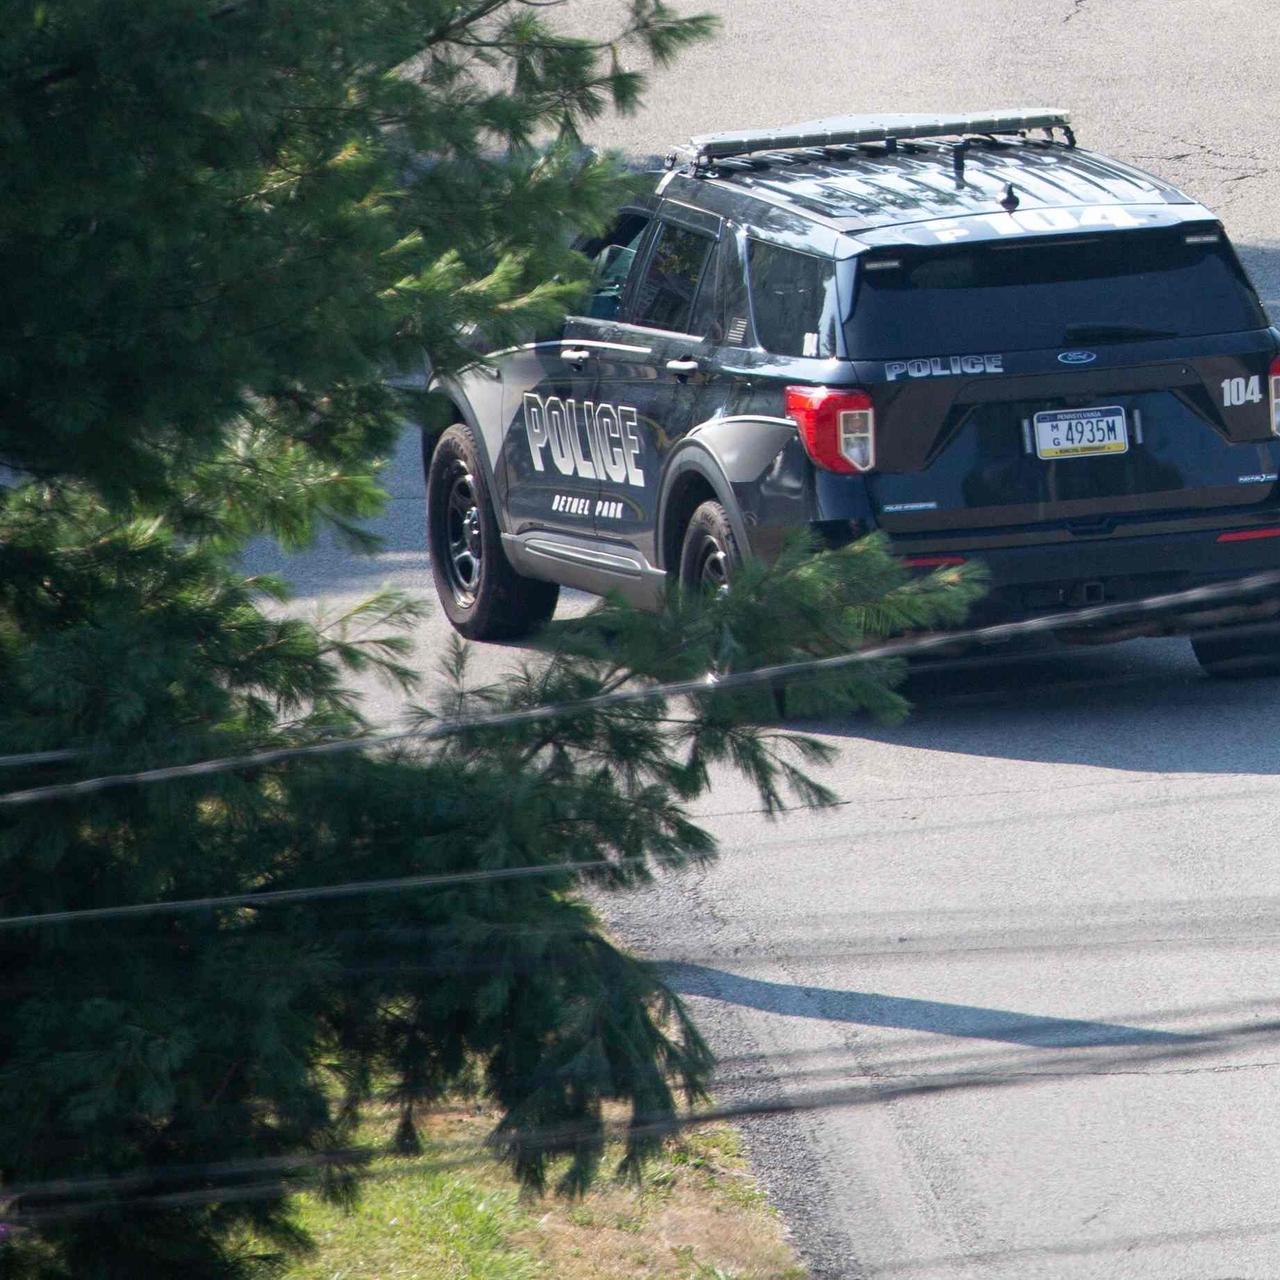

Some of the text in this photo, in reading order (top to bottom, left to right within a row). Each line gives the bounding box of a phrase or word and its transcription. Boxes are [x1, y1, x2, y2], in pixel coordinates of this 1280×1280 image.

[884, 354, 1004, 381] POLICE
[1221, 375, 1262, 407] 104
[523, 392, 645, 487] POLICE
[1050, 423, 1059, 432] M
[1066, 419, 1117, 445] 4935M
[1052, 437, 1061, 446] G
[552, 495, 623, 518] BETHEL PARK
